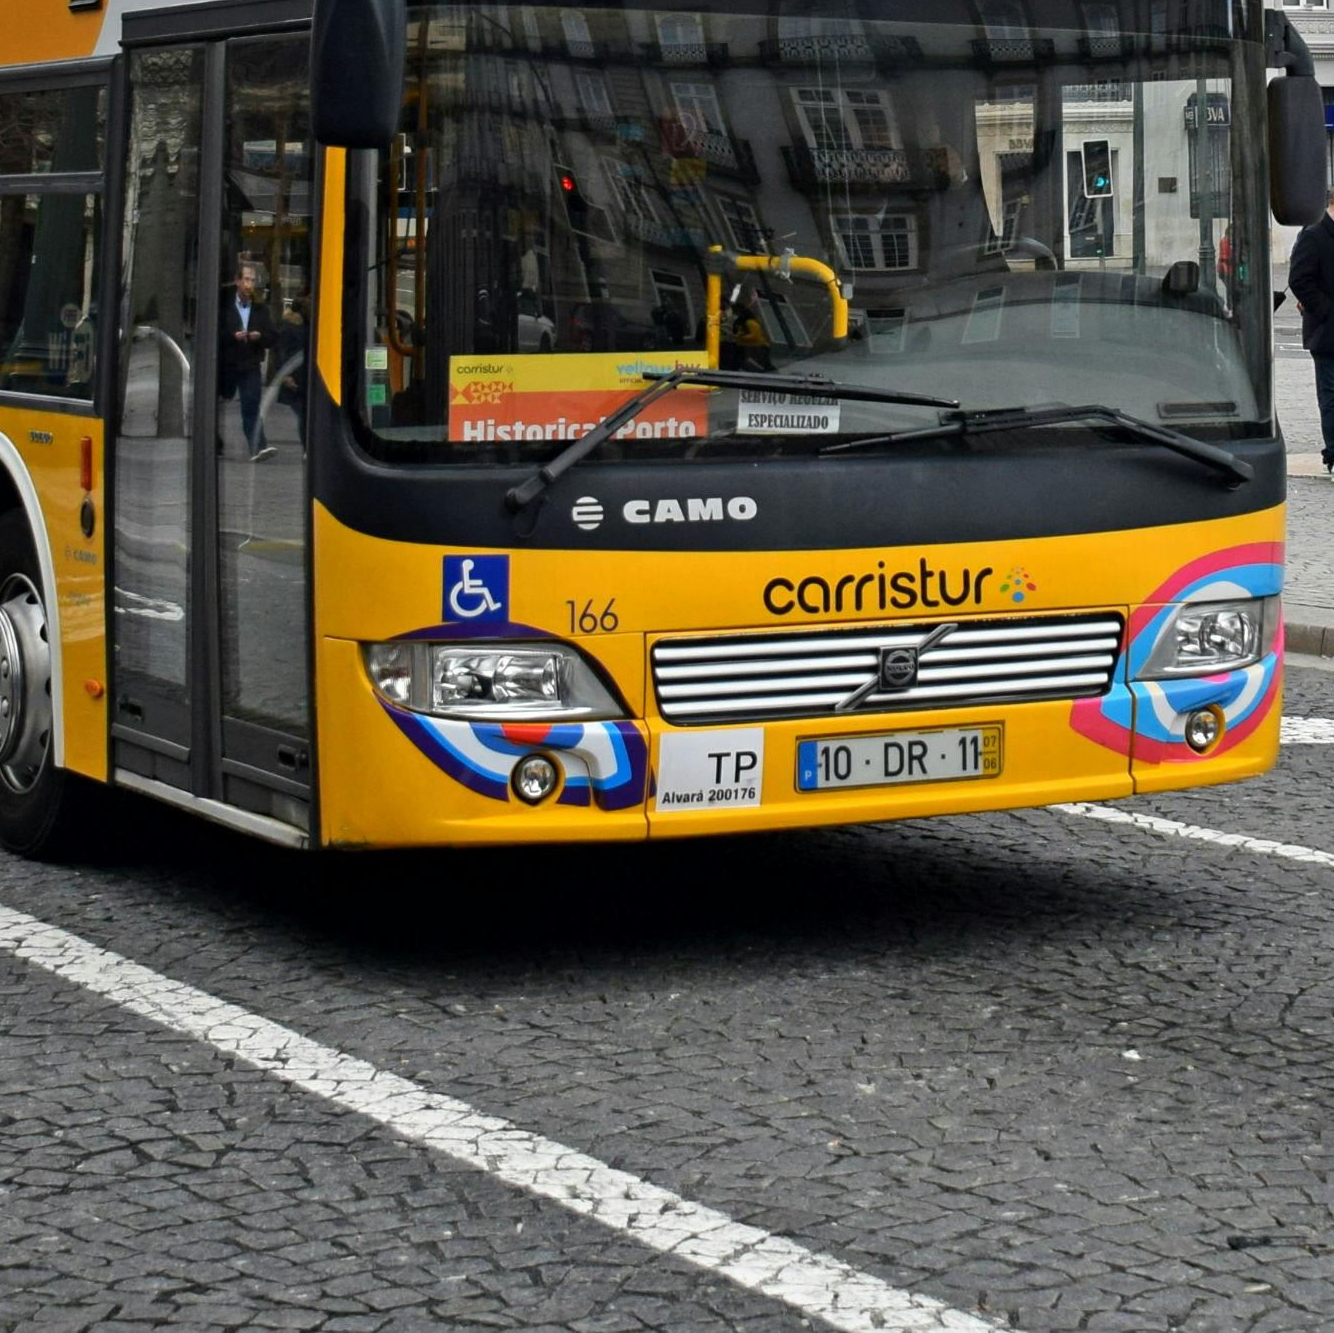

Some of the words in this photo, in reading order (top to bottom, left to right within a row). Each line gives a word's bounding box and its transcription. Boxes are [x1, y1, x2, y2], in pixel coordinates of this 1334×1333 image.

[457, 363, 505, 374] carristur
[741, 389, 786, 406] SERVIÇO
[616, 419, 696, 439] Porto
[748, 413, 829, 429] ESPECIALIZADO
[623, 496, 758, 523] CAMO
[763, 557, 993, 615] carristur
[566, 598, 619, 633] 166
[983, 734, 997, 749] 07
[707, 751, 758, 784] TP
[983, 757, 998, 770] 06
[804, 770, 812, 781] P
[662, 788, 704, 805] Alvará
[708, 787, 756, 802] 200176
